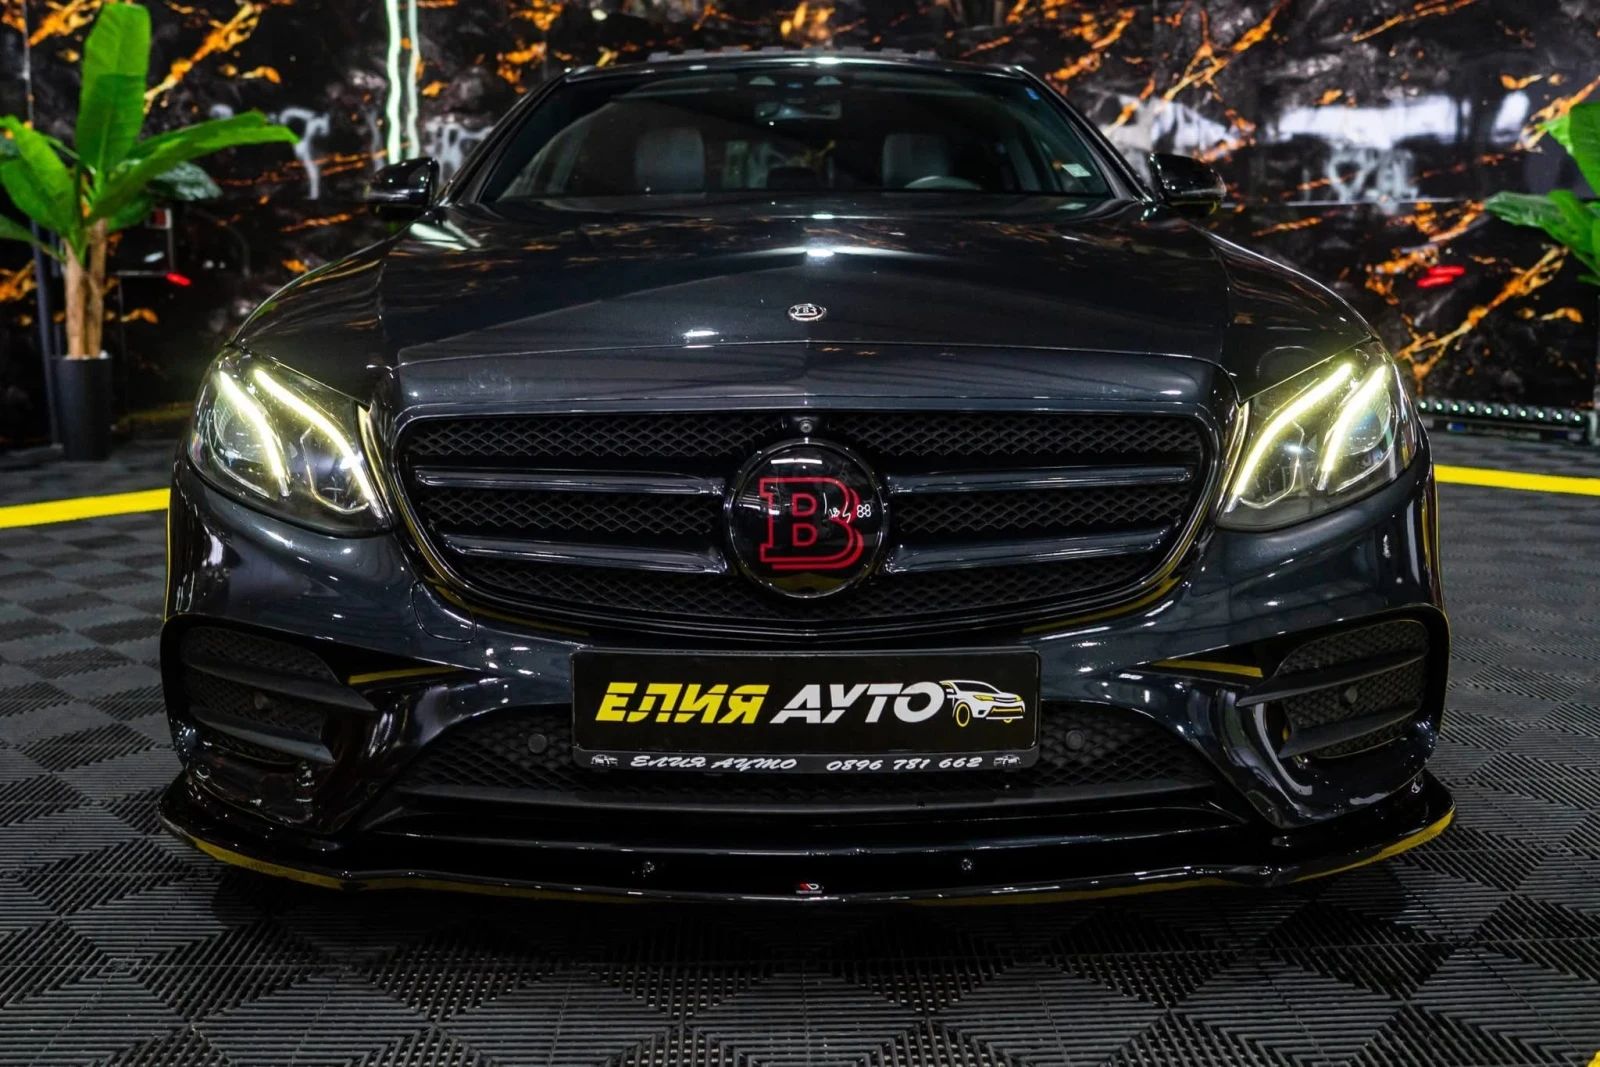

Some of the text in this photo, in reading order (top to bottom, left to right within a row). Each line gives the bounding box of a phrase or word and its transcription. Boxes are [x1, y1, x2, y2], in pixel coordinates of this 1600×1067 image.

[595, 681, 945, 724] ЕЛИЯ АУТО
[826, 759, 883, 771] 0896
[893, 758, 931, 770] 781
[938, 757, 983, 768] 662
